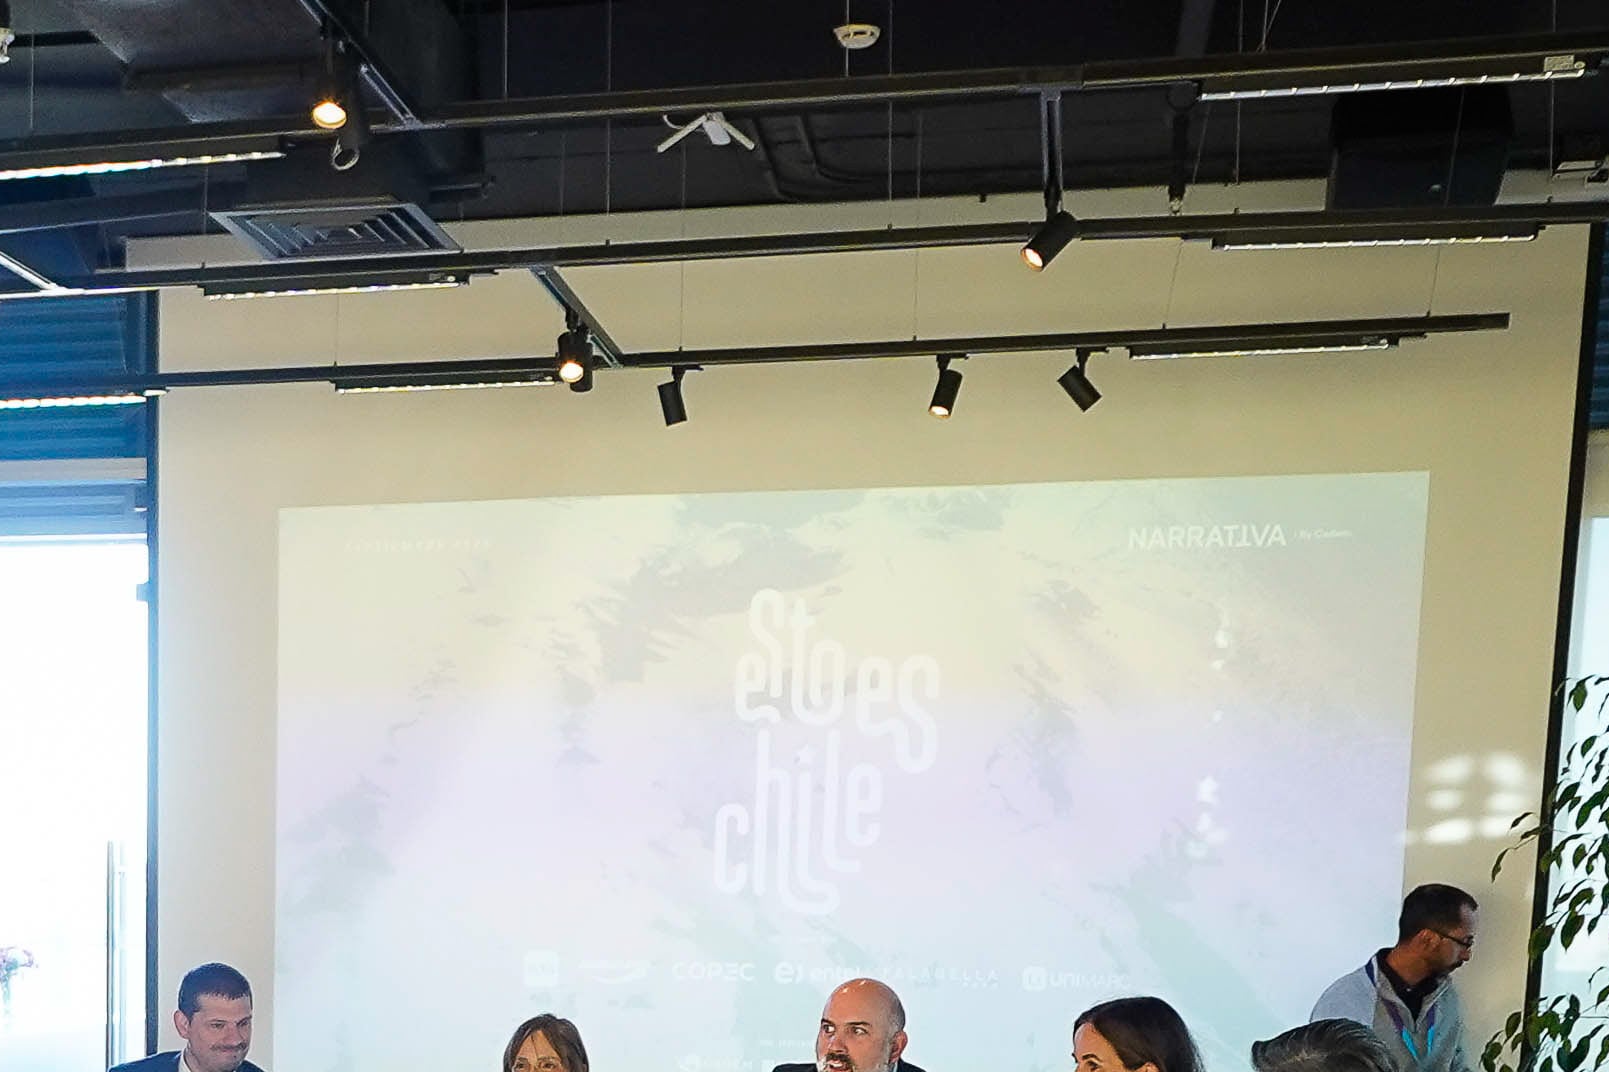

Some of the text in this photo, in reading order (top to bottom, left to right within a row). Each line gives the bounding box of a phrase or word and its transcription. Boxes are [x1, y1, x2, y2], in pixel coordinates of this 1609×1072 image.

[1128, 523, 1287, 550] NARRATIVA
[714, 728, 884, 916] chile
[671, 961, 756, 982] COPEC
